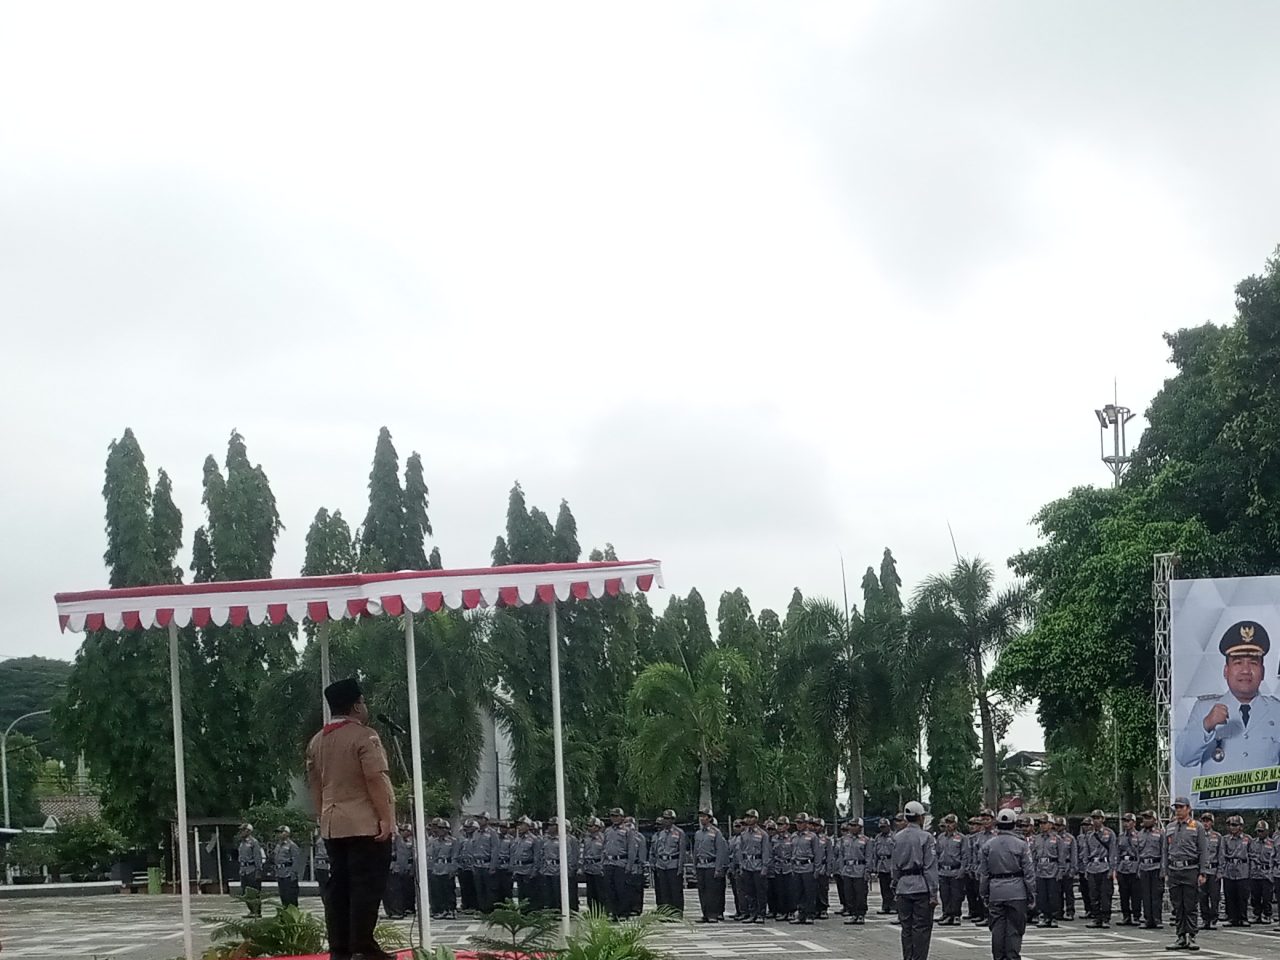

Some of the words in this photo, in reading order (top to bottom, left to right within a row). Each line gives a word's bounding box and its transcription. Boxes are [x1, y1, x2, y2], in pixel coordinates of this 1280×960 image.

[1195, 780, 1202, 790] H.
[1203, 778, 1222, 789] ARIEF
[1210, 789, 1238, 798] BUPATI
[1241, 784, 1266, 793] BLORA
